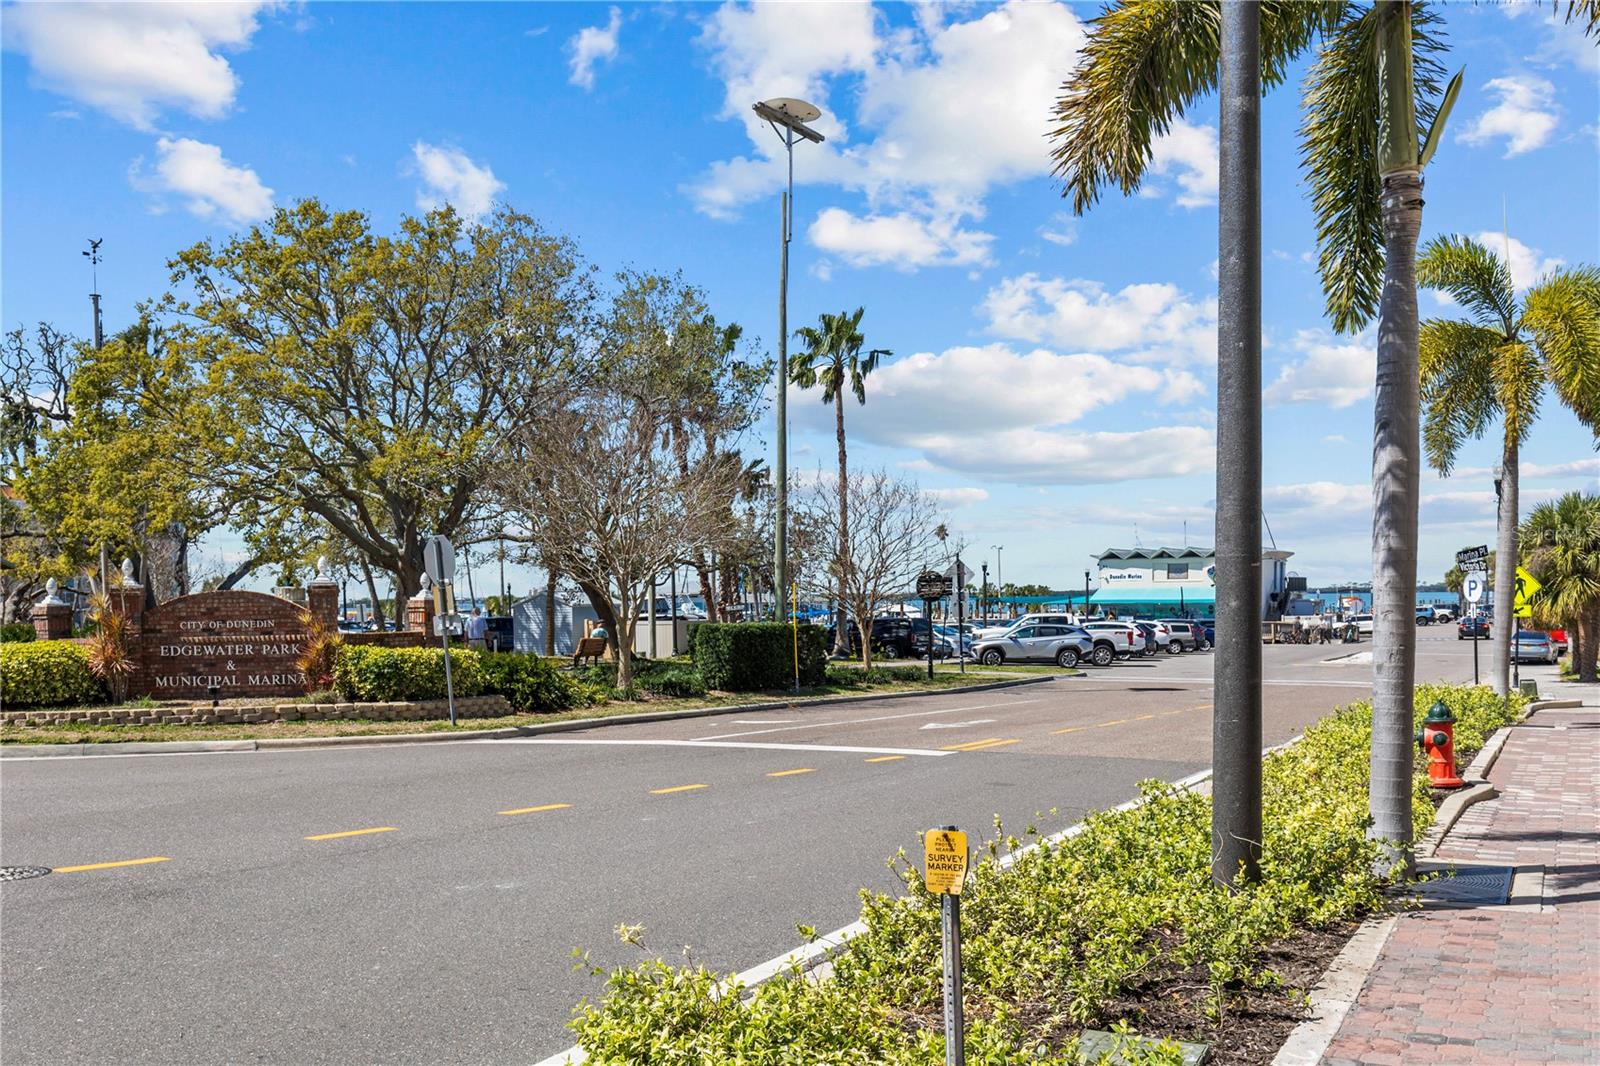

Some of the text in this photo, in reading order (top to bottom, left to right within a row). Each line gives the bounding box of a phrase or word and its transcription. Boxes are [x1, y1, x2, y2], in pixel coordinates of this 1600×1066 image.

[1468, 580, 1478, 596] P
[180, 619, 275, 630] CITY OF DUNEDIN
[160, 643, 301, 657] EDGEWATER PARK
[226, 659, 237, 671] &
[155, 673, 308, 688] MUNICIPAL MARINA
[928, 853, 964, 863] SURVEY
[928, 863, 964, 872] MARKER
